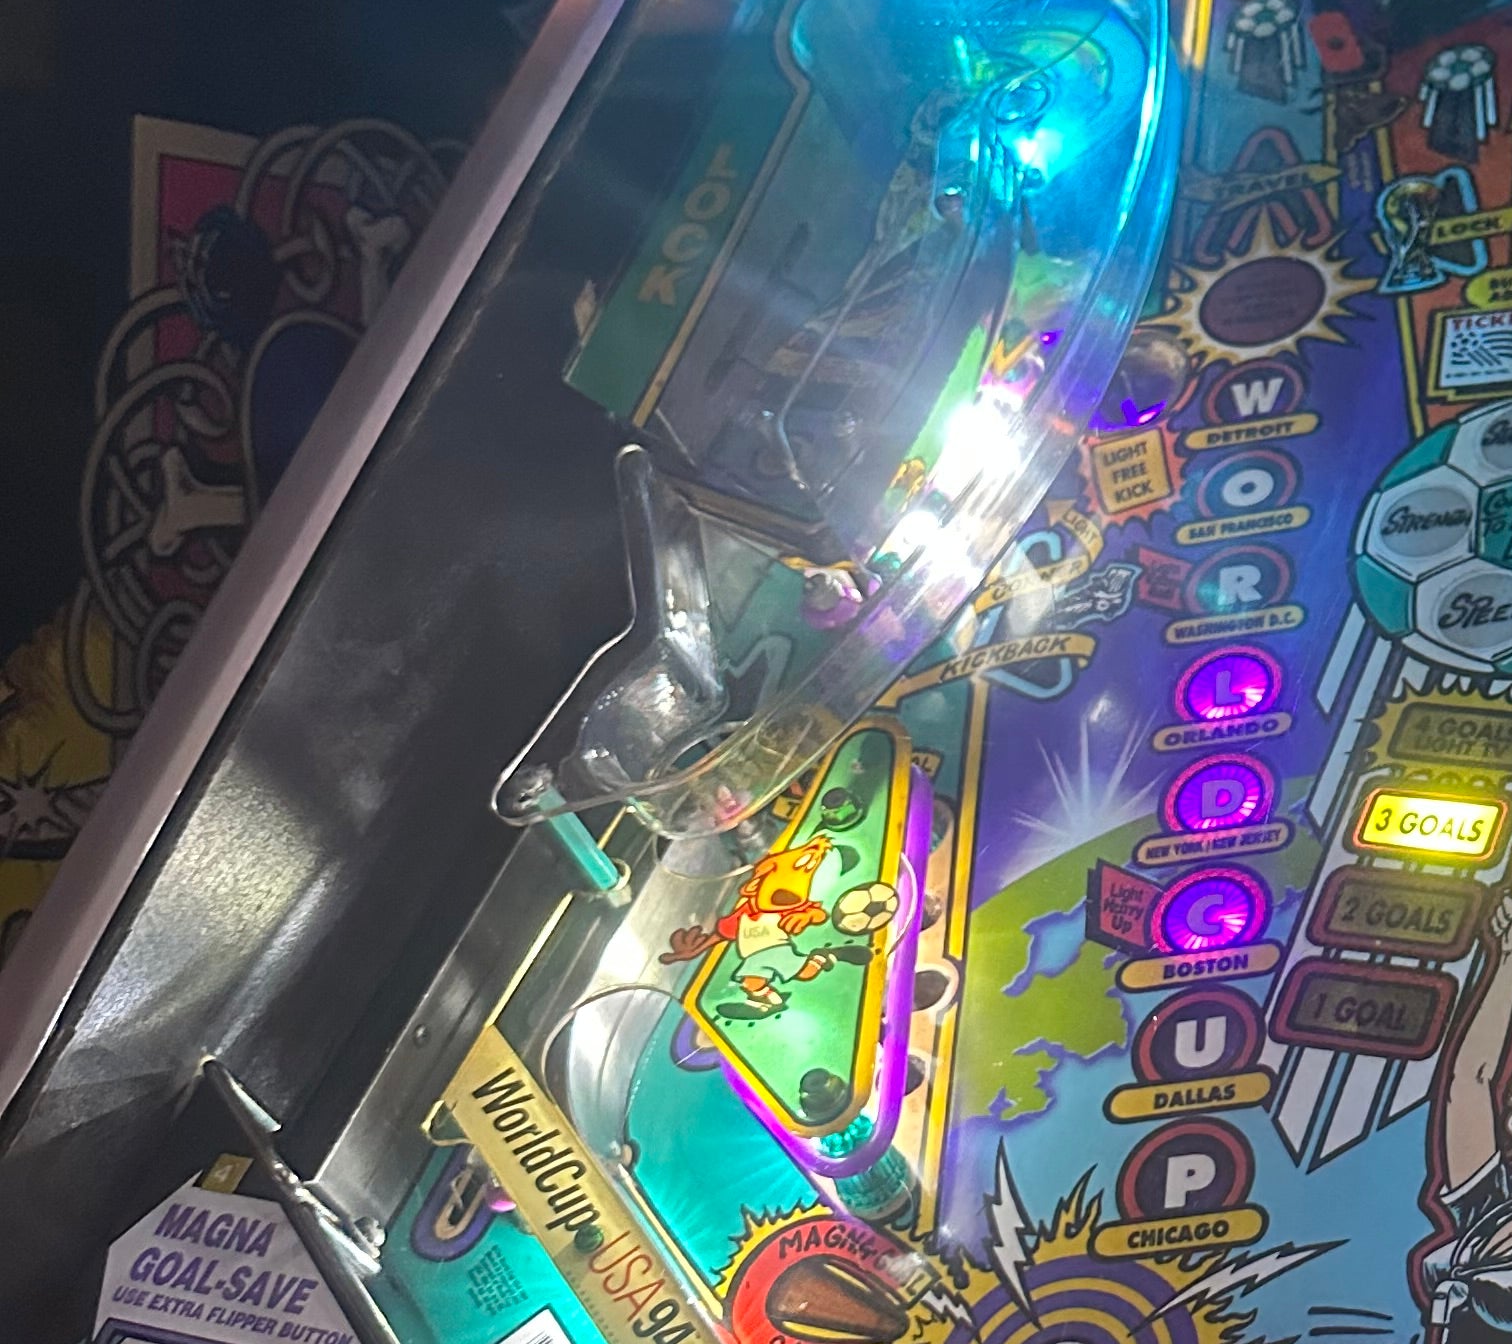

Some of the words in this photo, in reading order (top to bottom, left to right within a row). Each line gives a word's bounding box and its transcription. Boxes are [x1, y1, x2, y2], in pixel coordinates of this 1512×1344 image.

[1437, 216, 1502, 240] LOCK
[1232, 377, 1284, 417] W
[1207, 421, 1295, 445] DETROIT
[1102, 441, 1149, 468] LIGHT
[1112, 462, 1148, 484] FREE
[1222, 468, 1274, 506] O
[1114, 480, 1155, 505] KICK
[1220, 513, 1294, 534] FRANCISCO
[1218, 564, 1263, 606] R
[1175, 614, 1265, 639] WASHINGTON
[940, 635, 1072, 681] KICKBACK
[1215, 669, 1242, 706] L
[1164, 718, 1280, 747] ORLANDO
[1201, 778, 1246, 819] D
[1375, 807, 1392, 832] 3
[1399, 812, 1484, 843] GOALS
[1110, 883, 1144, 904] Light
[1112, 916, 1133, 935] Up
[1186, 893, 1225, 936] C
[1341, 895, 1358, 923] 2
[1371, 897, 1454, 934] GOALS
[1162, 954, 1249, 980] BOSTON
[1312, 993, 1324, 1019] 1
[1335, 995, 1409, 1031] GOAL
[1176, 1016, 1227, 1068] U
[1153, 1082, 1236, 1110] DALLAS
[1165, 1154, 1216, 1208] P
[155, 1203, 278, 1257] MAGNA
[1127, 1219, 1230, 1249] CHICAGO
[129, 1247, 318, 1316] GOAL-SAVE
[113, 1286, 144, 1304] USE
[147, 1293, 206, 1321] EXTRA
[206, 1306, 275, 1336] FLIPPER
